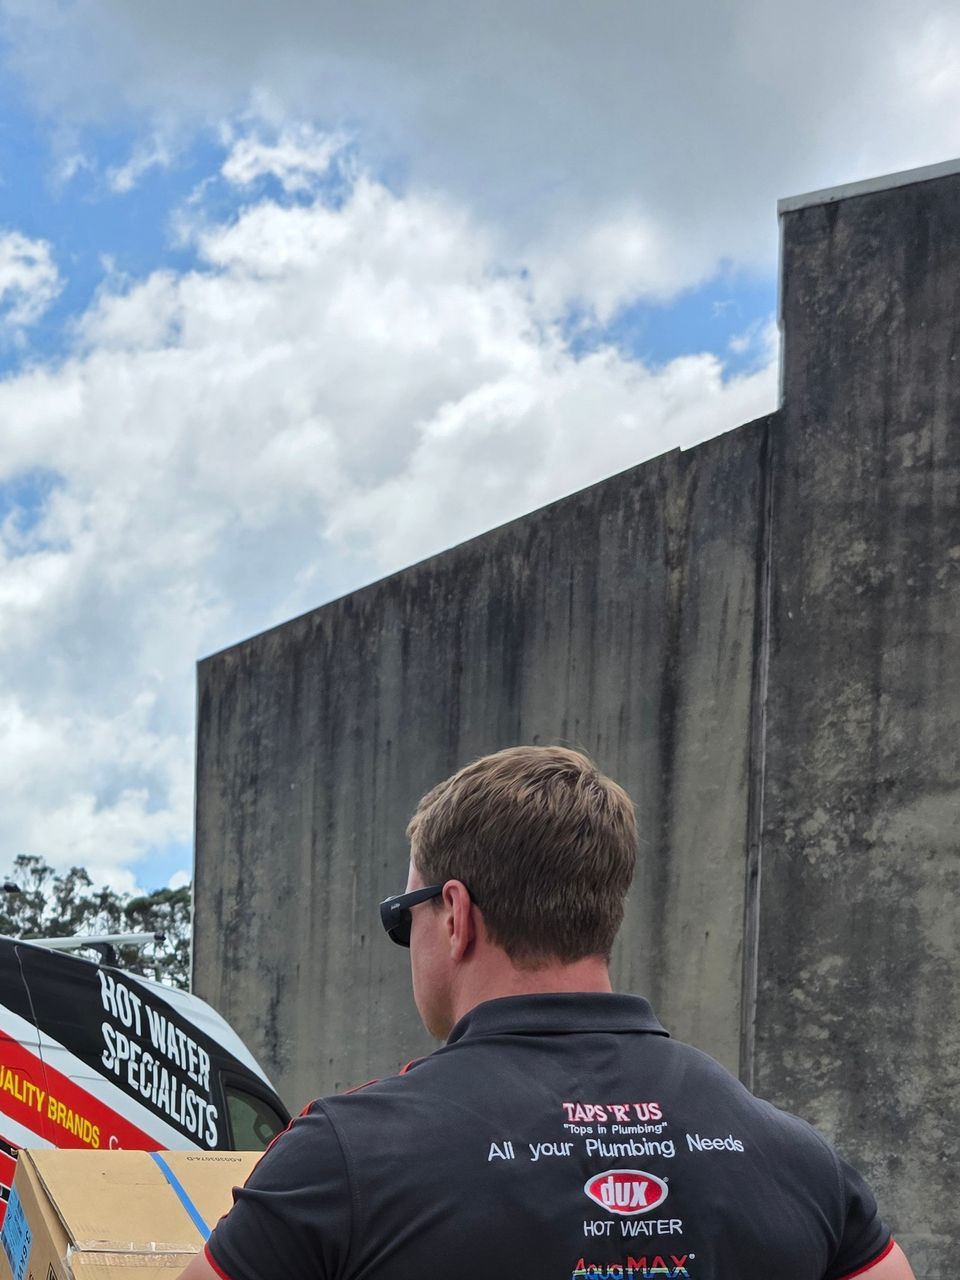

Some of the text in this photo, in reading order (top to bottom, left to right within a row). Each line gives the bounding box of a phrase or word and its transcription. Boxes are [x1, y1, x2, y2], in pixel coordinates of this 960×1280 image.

[96, 968, 211, 1091] HOT WATER
[101, 1022, 218, 1147] SPECIALISTS
[48, 1096, 100, 1149] BRANDS
[562, 1102, 607, 1122] TAPS
[637, 1103, 663, 1122] US
[597, 1124, 607, 1134] in
[488, 1133, 744, 1161] All your Plumbing Needs
[601, 1176, 649, 1207] dux
[583, 1219, 683, 1237] HOT WATER
